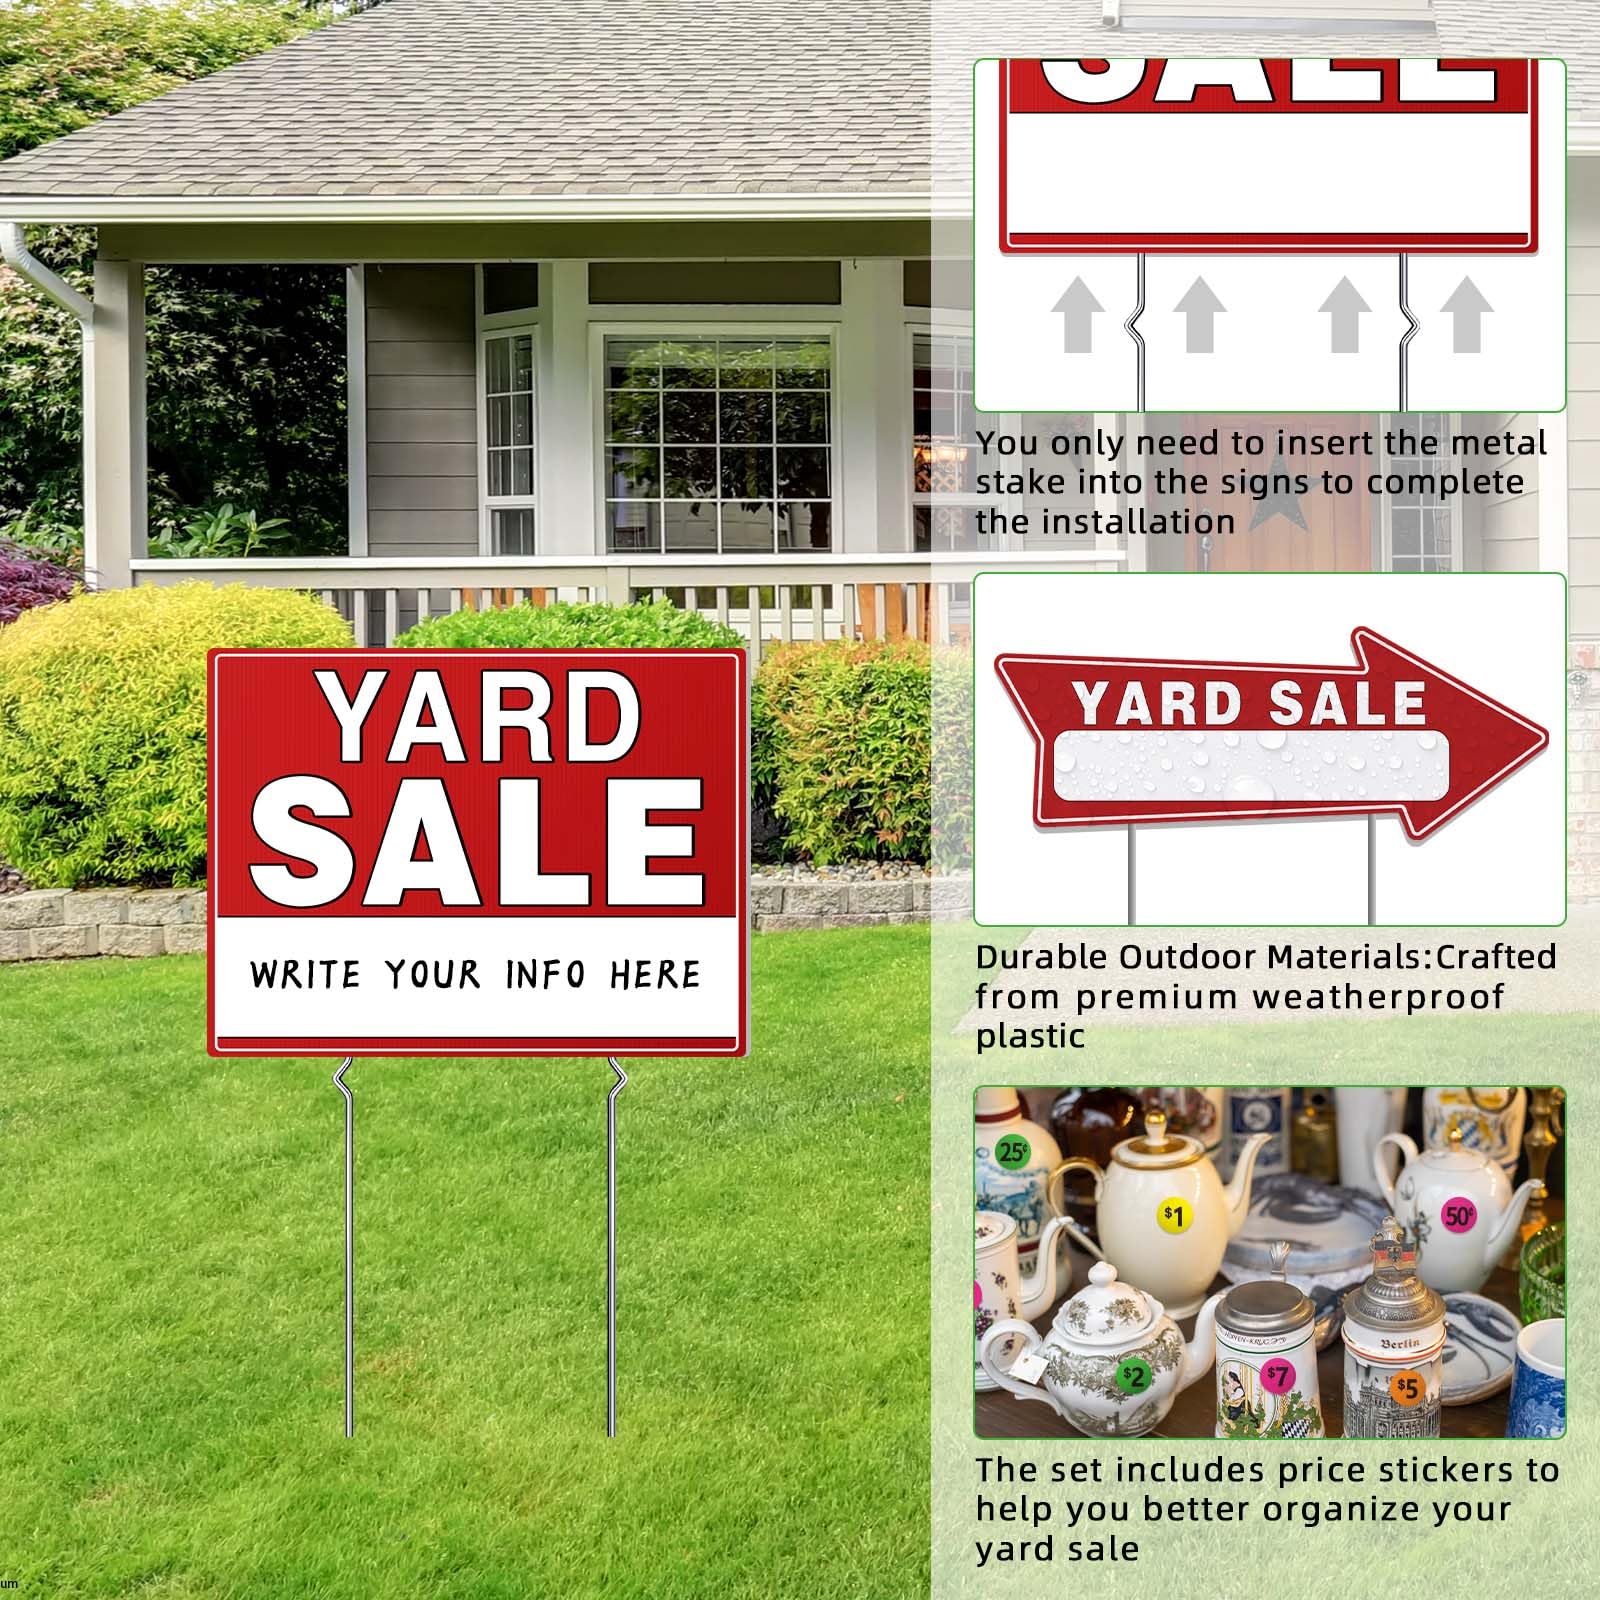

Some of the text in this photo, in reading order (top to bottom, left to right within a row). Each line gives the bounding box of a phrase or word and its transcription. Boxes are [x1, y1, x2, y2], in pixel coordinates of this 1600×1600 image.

[1072, 680, 1426, 726] YARD SALE
[313, 669, 641, 764] YARD
[249, 774, 706, 909] SALE
[250, 958, 700, 991] WRITE YOUR INFO HERE
[1000, 1142, 1027, 1162] 25¢
[1164, 1206, 1183, 1227] $1
[1446, 1206, 1474, 1227] 50¢
[1381, 1338, 1421, 1350] Berlin
[1123, 1367, 1145, 1387] $2
[1267, 1366, 1289, 1388] $7
[1397, 1378, 1419, 1400] $5
